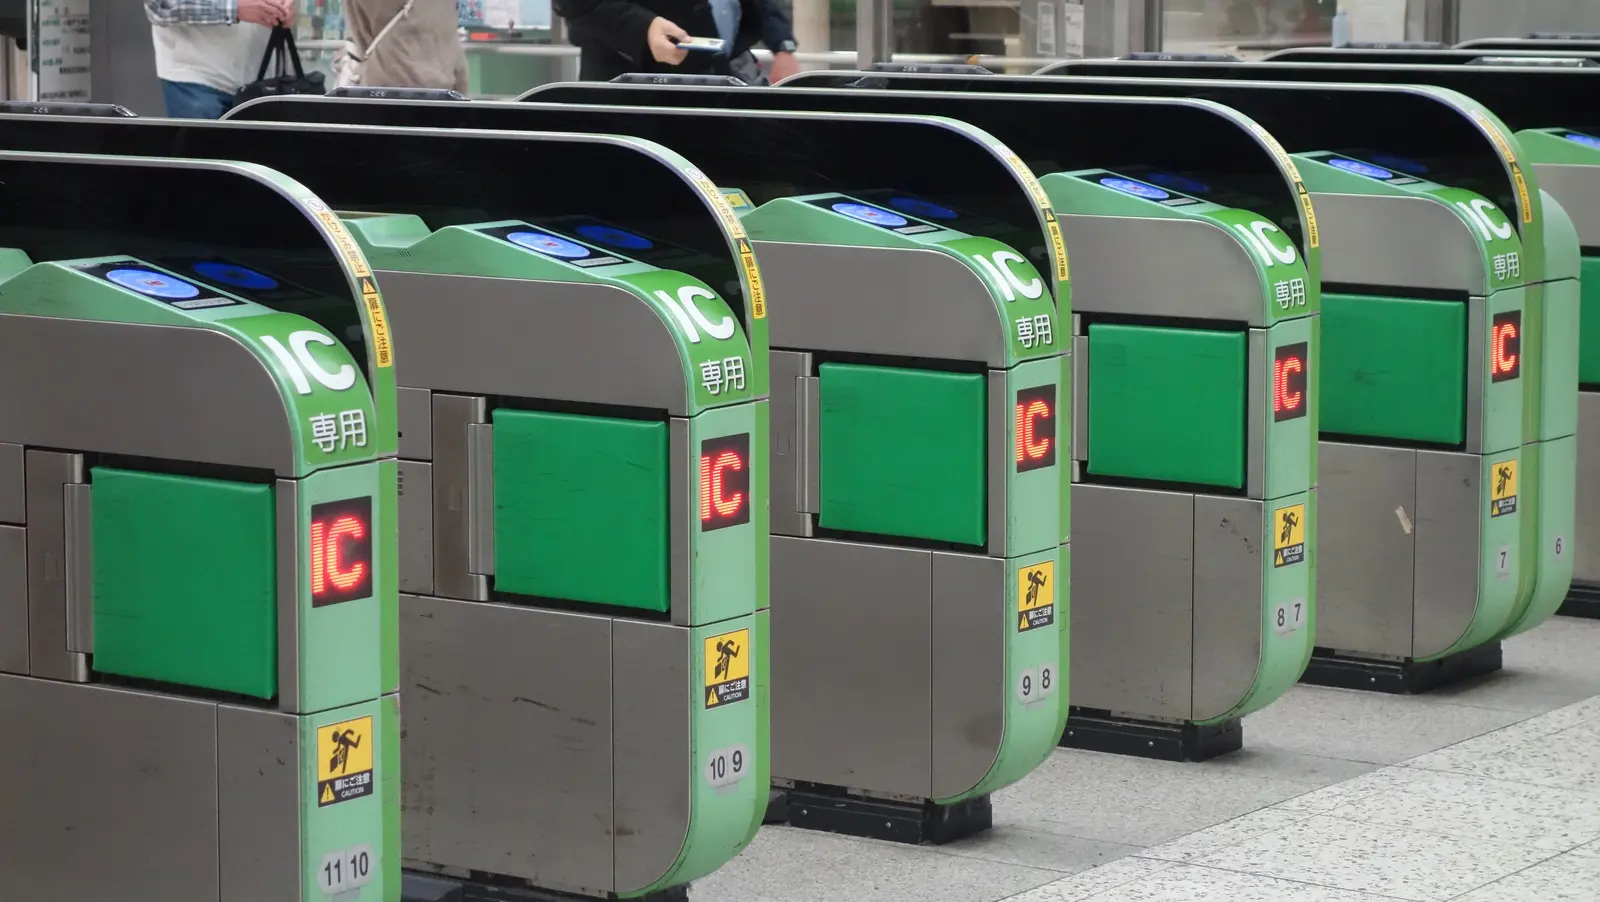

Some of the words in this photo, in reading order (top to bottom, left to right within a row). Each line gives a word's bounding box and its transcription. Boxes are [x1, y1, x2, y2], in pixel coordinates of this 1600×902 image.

[1456, 199, 1512, 241] IC
[1233, 221, 1296, 267] IC
[972, 251, 1043, 302] IC
[1493, 252, 1520, 280] 専用
[1274, 278, 1306, 309] 専用
[653, 286, 735, 343] IC
[1015, 314, 1052, 348] 専用
[259, 331, 355, 394] IC
[1492, 323, 1516, 374] IC
[699, 356, 745, 394] 専用
[1274, 356, 1301, 412] IC
[309, 408, 366, 452] 専用
[1017, 401, 1048, 461] IC
[701, 453, 742, 519] IC
[312, 517, 363, 593] IC
[1500, 551, 1507, 568] 7
[1556, 537, 1562, 554] 6
[1032, 617, 1048, 626] CAUTION
[1277, 607, 1285, 627] 8
[1294, 603, 1301, 622] 7
[723, 691, 743, 702] CAUTION
[1022, 675, 1031, 697] 9
[1042, 668, 1050, 690] 8
[710, 756, 725, 780] 10
[732, 750, 743, 773] 9
[341, 786, 365, 799] CAUTION
[324, 860, 341, 886] 11
[350, 851, 369, 879] 10
